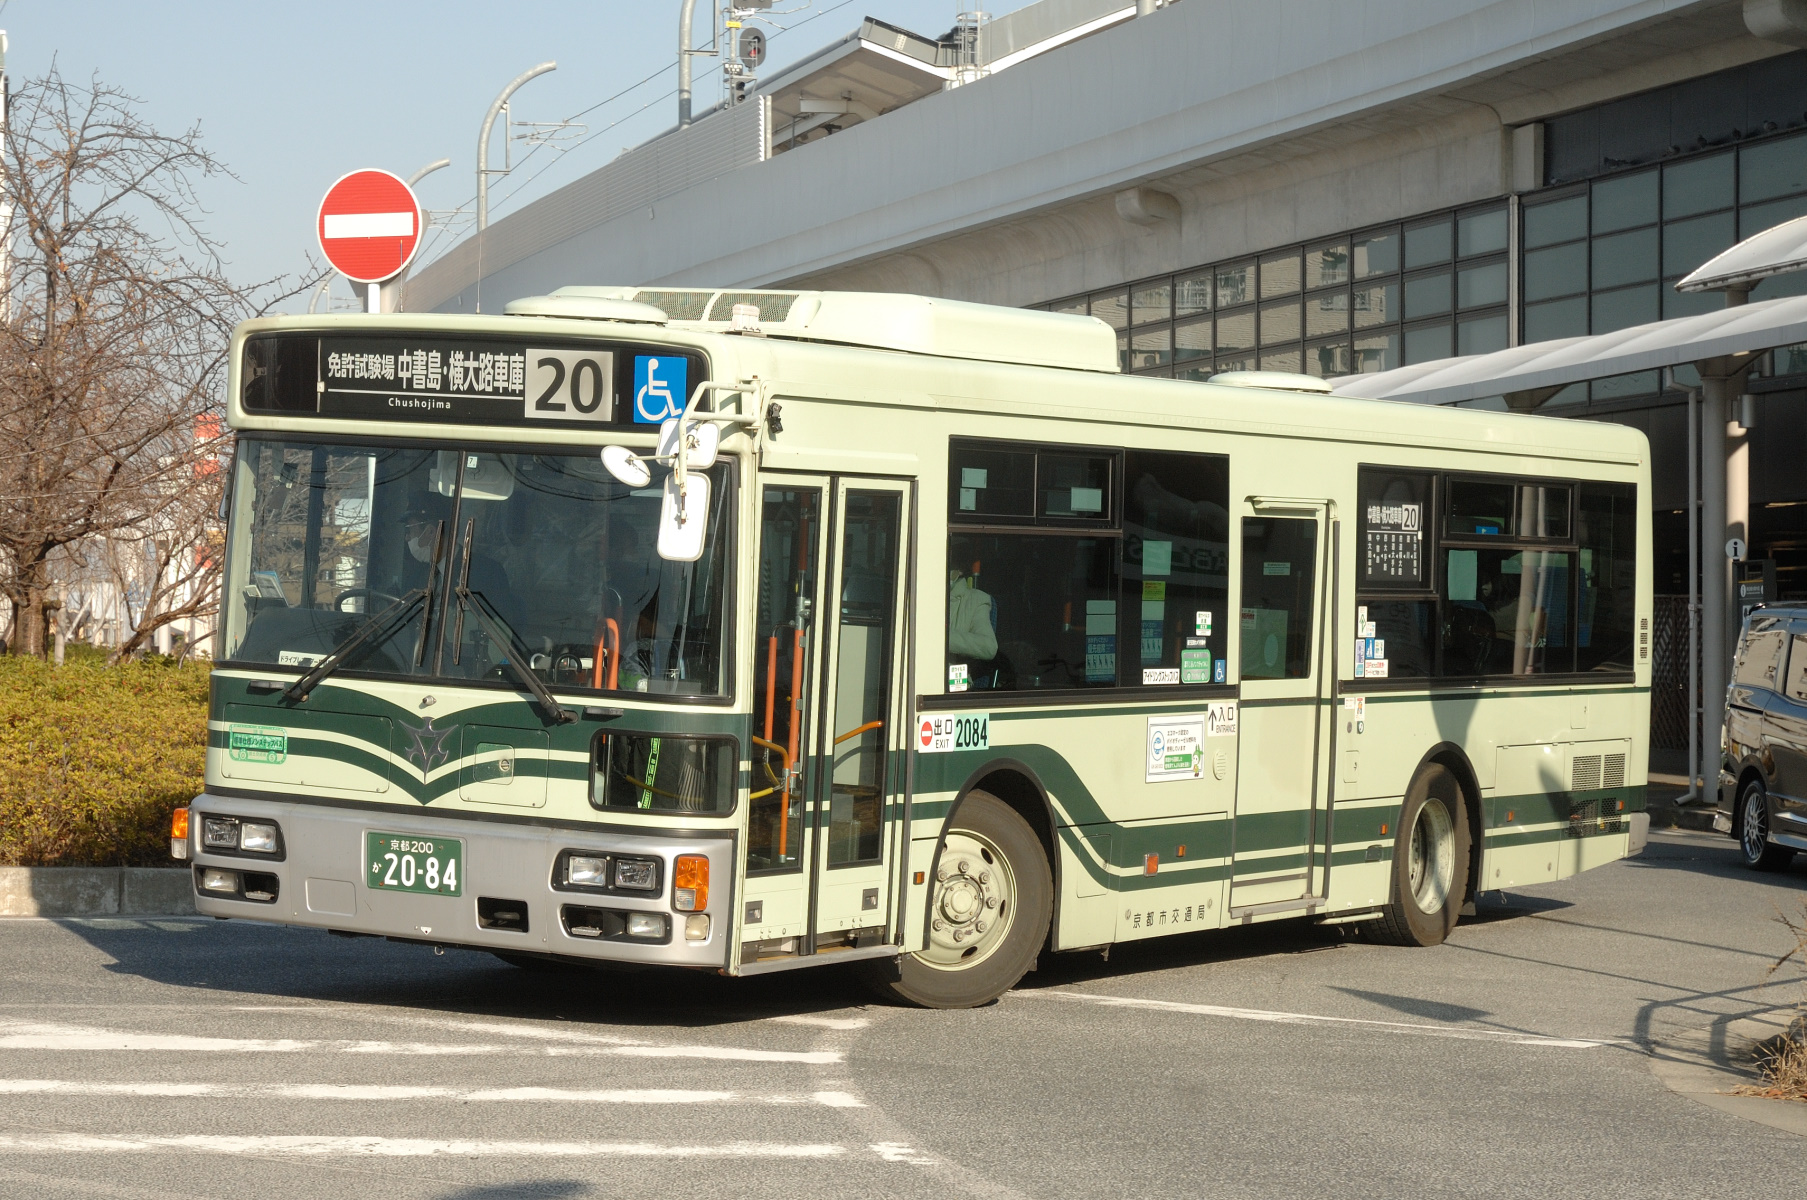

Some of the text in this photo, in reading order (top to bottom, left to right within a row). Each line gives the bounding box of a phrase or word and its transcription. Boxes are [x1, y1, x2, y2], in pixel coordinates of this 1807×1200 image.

[327, 349, 524, 394] 免許試験場 中書島・横大路車庫
[535, 357, 604, 414] 20
[388, 397, 451, 411] Chushojima
[1403, 507, 1417, 528] 20
[1218, 706, 1234, 722] 入口
[934, 718, 953, 735] 出口
[955, 718, 987, 748] 2084
[1216, 724, 1236, 734] ENTRANCE
[935, 739, 950, 749] EXIT
[372, 853, 457, 891] か 20-84
[1132, 904, 1205, 929] 京都市交通局
